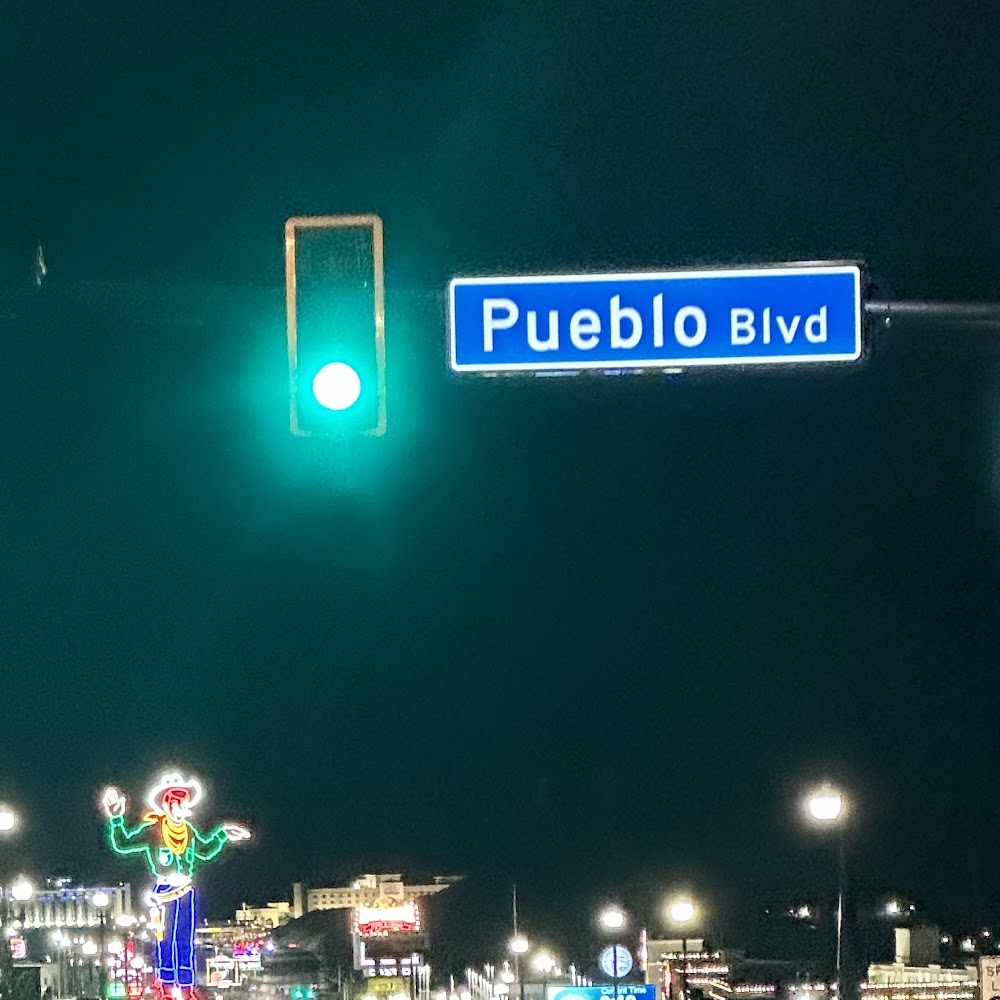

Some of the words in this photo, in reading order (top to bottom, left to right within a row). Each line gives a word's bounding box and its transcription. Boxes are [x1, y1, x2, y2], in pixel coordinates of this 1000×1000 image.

[482, 293, 708, 353] Pueblo
[730, 305, 829, 347] Blvd
[600, 987, 628, 995] Curnt
